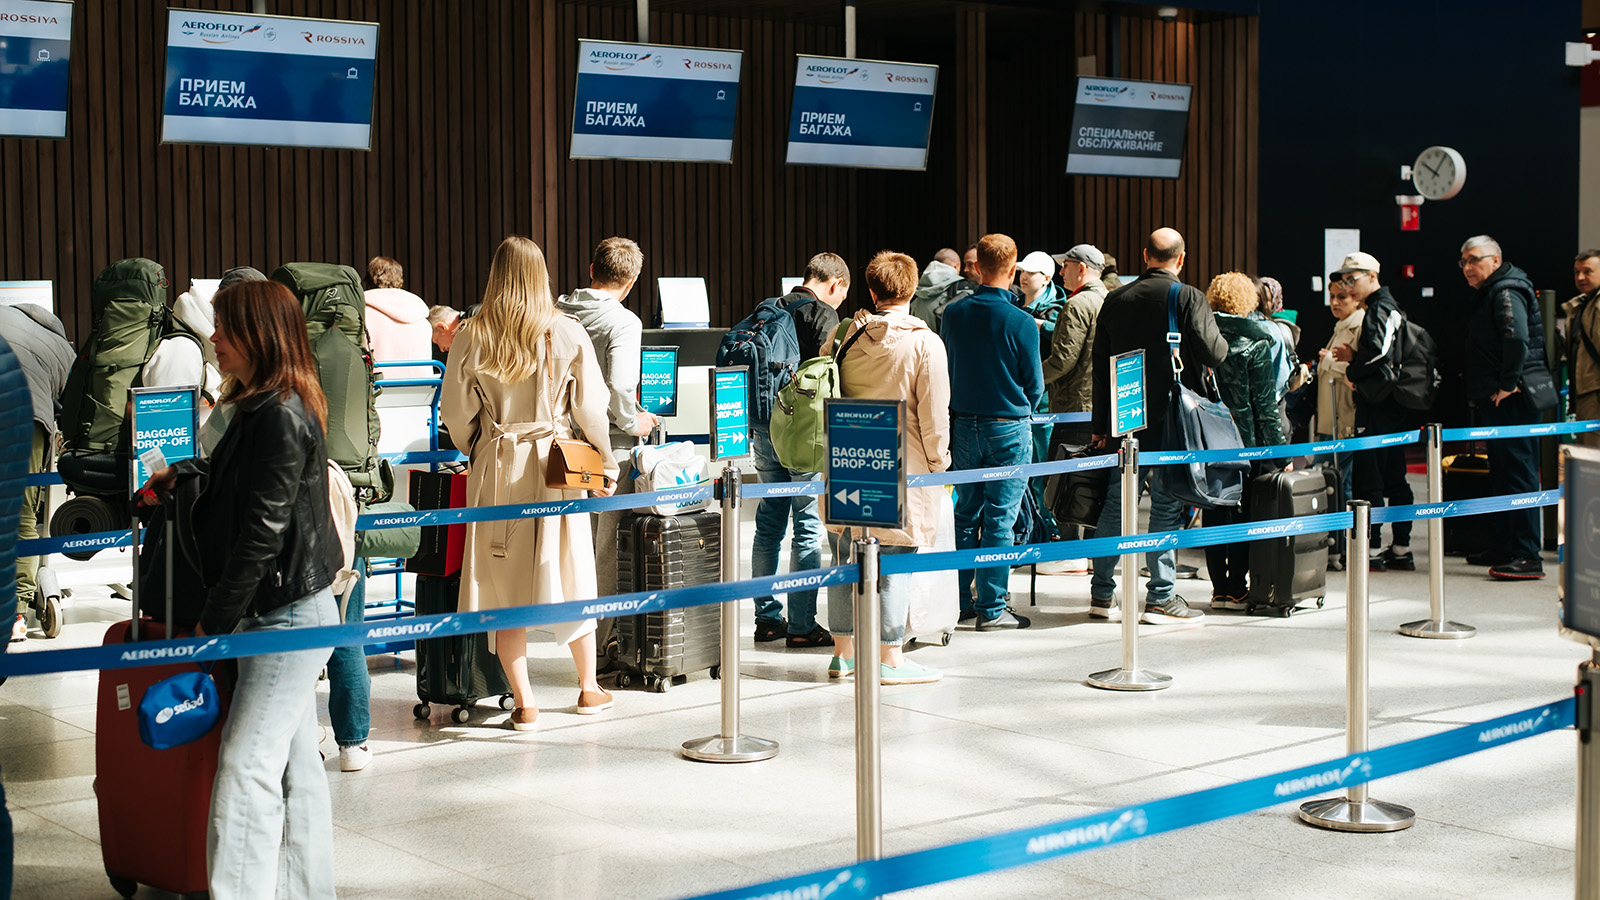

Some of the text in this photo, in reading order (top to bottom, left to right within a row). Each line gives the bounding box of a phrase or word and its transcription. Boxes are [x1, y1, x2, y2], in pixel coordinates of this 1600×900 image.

[0, 13, 58, 24] ROSSIYA
[181, 21, 245, 32] AEROFLOT
[316, 34, 366, 45] ROSSIYA
[590, 50, 639, 60] AEROFLOT
[694, 62, 733, 71] ROSSIYA
[805, 65, 849, 75] AEROFLOT
[180, 77, 246, 94] ПРИЕМ
[895, 75, 929, 84] ROSSIYA
[1084, 84, 1119, 94] AEROFLOT
[179, 92, 257, 109] БАГАЖА
[586, 100, 638, 115] ПРИЕМ
[585, 113, 646, 128] БАГАЖА
[800, 111, 846, 125] ПРИЕМ
[799, 123, 852, 137] БАГАЖА
[1079, 126, 1156, 141] СПЕЦИАЛЬНОЕ
[1077, 137, 1164, 152] ОБСЛУЖИВАНИЕ
[136, 427, 188, 440] BAGGAGE
[137, 436, 191, 449] DROP-OFF
[832, 446, 891, 460] BAGGAGE
[832, 458, 895, 471] DROP-OFF
[1076, 459, 1104, 469] AEROFLOT
[982, 470, 1011, 479] AEROFLOT
[655, 491, 694, 502] AEROFLOT
[766, 486, 801, 495] AEROFLOT
[1511, 496, 1538, 506] AEROFLOT
[521, 505, 562, 515] AEROFLOT
[1415, 507, 1445, 516] AEROFLOT
[373, 516, 418, 526] AEROFLOT
[1247, 525, 1286, 536] AEROFLOT
[62, 536, 117, 549] AEROFLOT
[1117, 538, 1159, 550] AEROFLOT
[974, 552, 1020, 563] AEROFLOT
[771, 575, 823, 591] AEROFLOT
[581, 600, 640, 616] AEROFLOT
[366, 622, 433, 639] AEROFLOT
[119, 645, 195, 662] AEROFLOT
[173, 692, 204, 716] pegas
[1478, 718, 1533, 743] AEROFLOT
[1274, 768, 1341, 797] AEROFLOT
[1026, 822, 1109, 855] AEROFLOT
